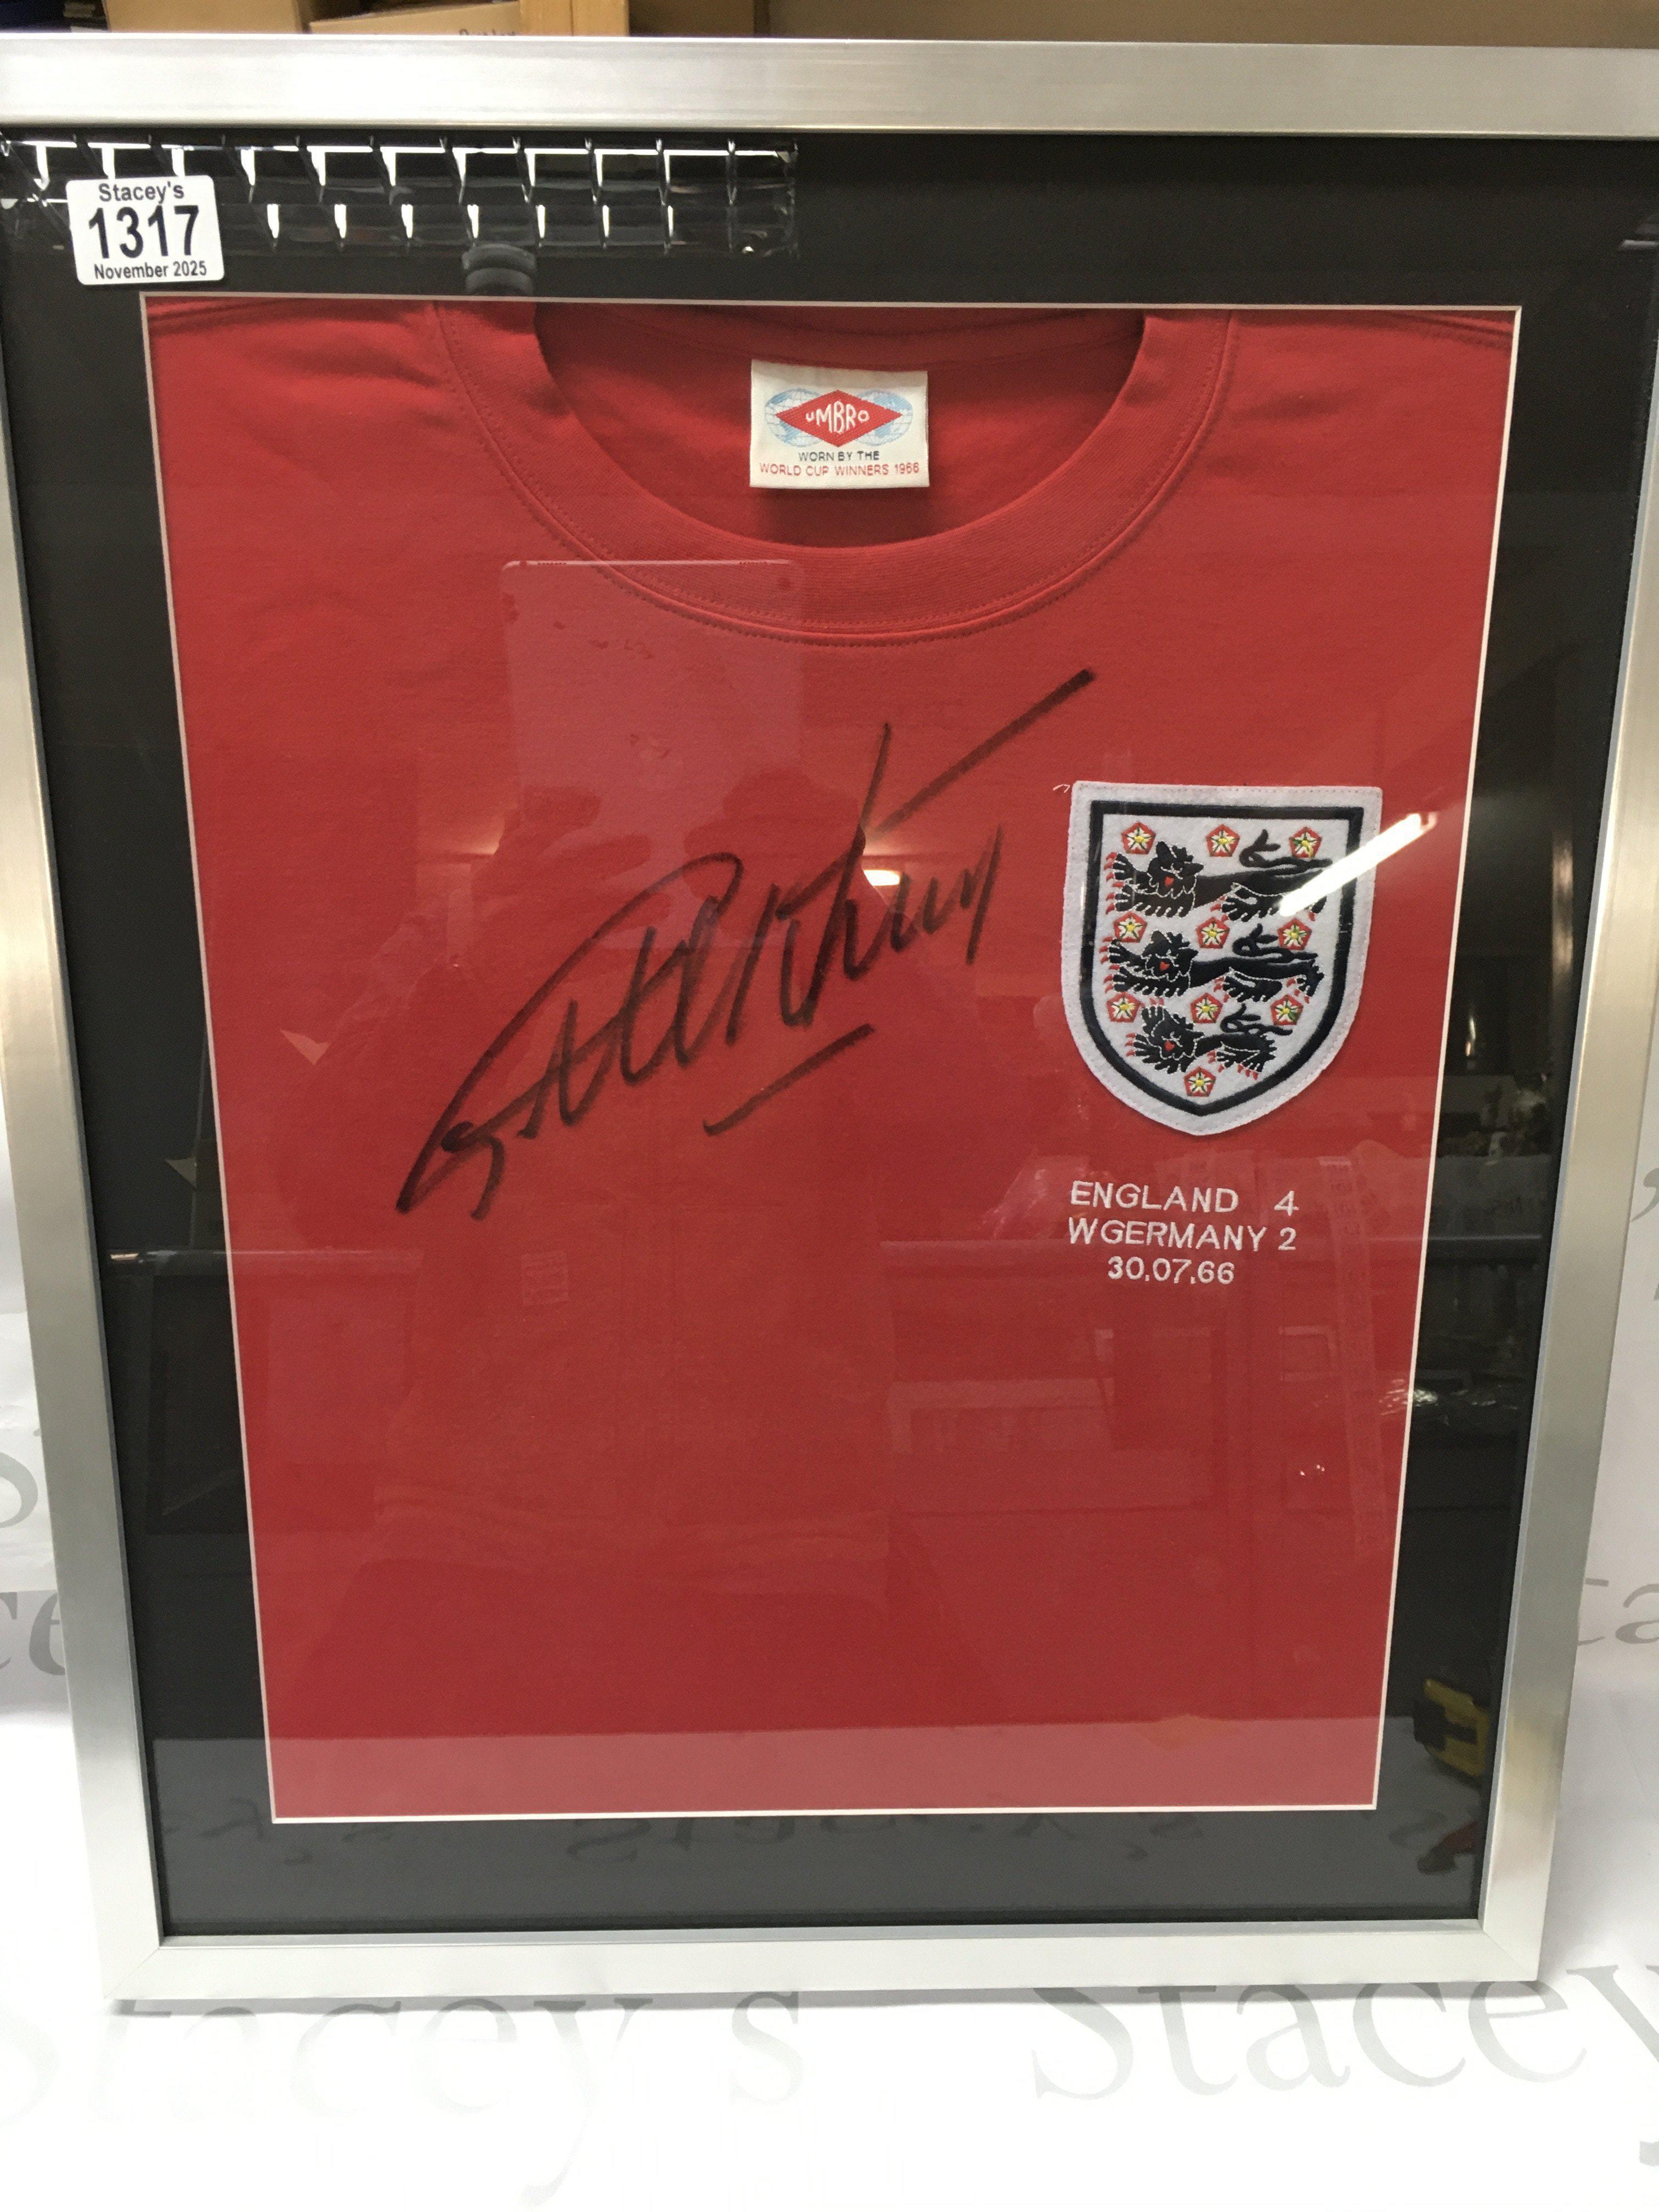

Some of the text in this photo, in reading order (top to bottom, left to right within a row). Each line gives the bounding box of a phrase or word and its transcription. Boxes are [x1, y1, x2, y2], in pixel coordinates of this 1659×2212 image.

[98, 181, 185, 205] Stacey's
[88, 205, 200, 259] 1317
[94, 260, 207, 280] November 2025
[798, 450, 880, 462] WORN BY THE
[759, 462, 802, 476] WORLD
[805, 465, 830, 476] CUP
[834, 464, 889, 476] WINNERS
[1070, 1180, 1299, 1216] ENGLAND 4
[1277, 1226, 1297, 1251] 2
[1107, 1255, 1235, 1284] 30.07.66
